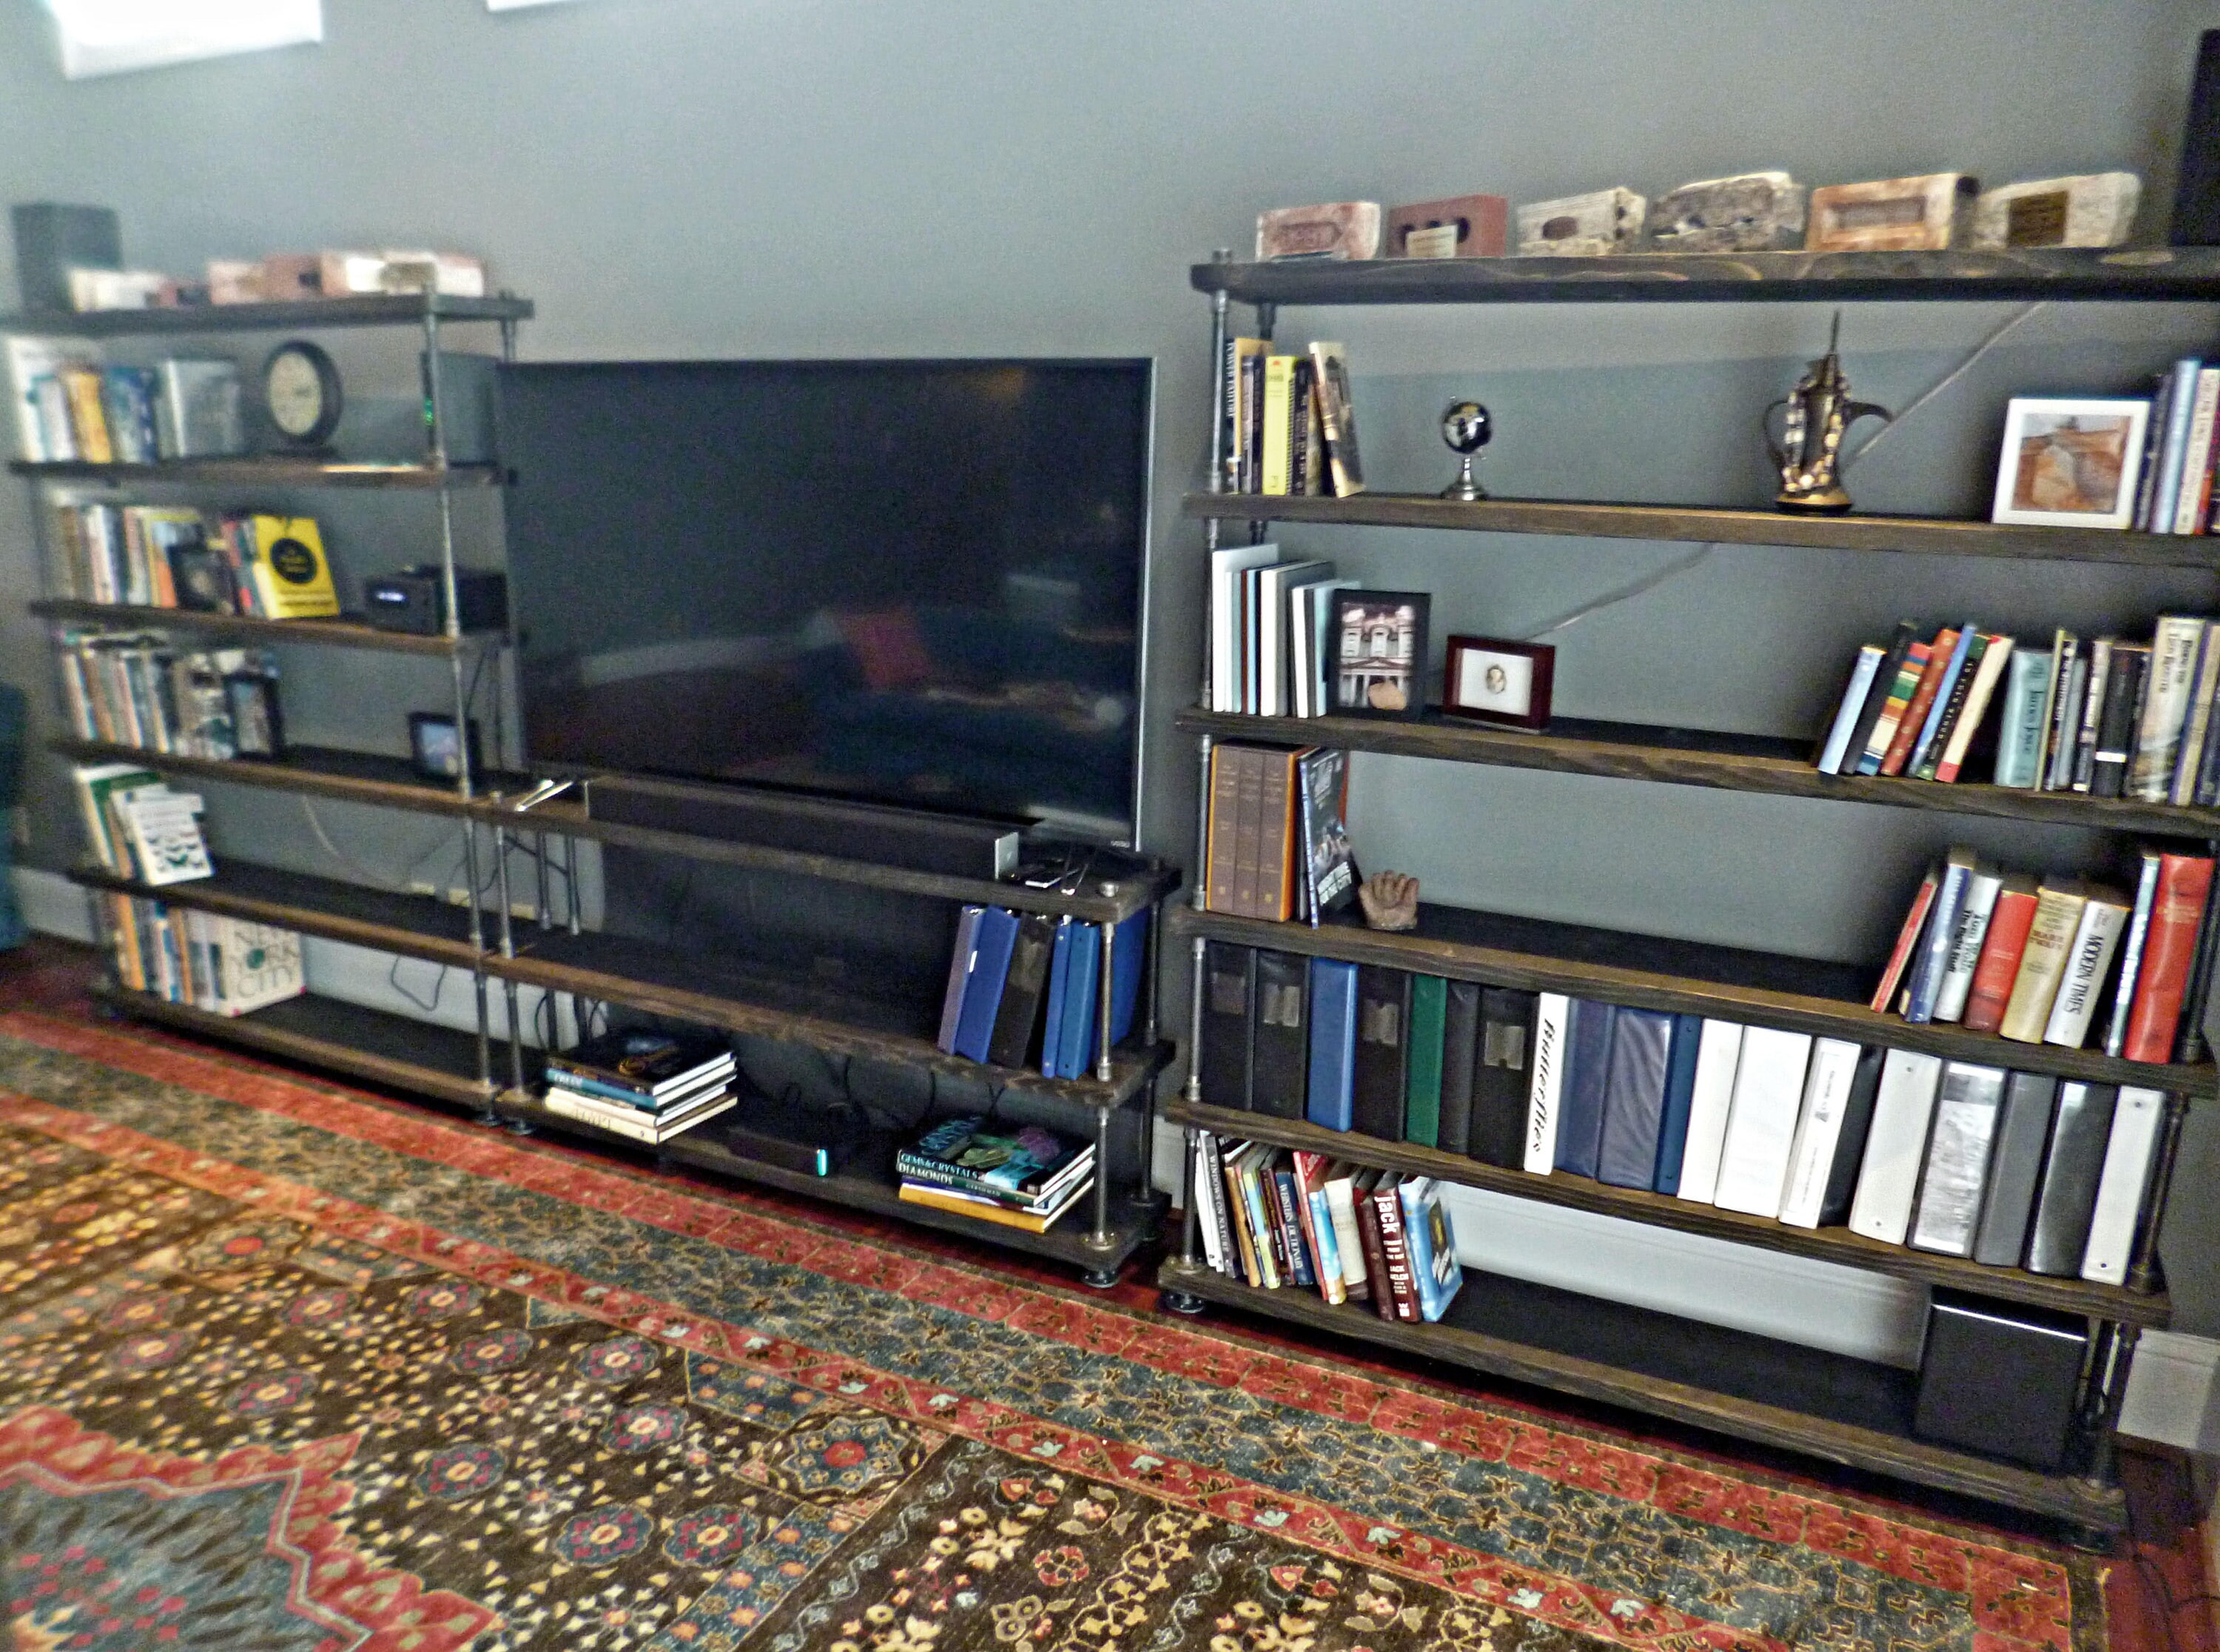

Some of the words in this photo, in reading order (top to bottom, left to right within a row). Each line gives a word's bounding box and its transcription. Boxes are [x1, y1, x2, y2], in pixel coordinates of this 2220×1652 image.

[2077, 934, 2105, 981] MODERN
[2063, 981, 2090, 1016] TIMES
[1533, 1018, 1555, 1152] Butterflies
[898, 1162, 953, 1185] DIAMONDS
[1209, 1155, 1221, 1200] WINDOWS
[1215, 1201, 1223, 1215] ON
[1373, 1196, 1401, 1235] jack
[1218, 1216, 1230, 1253] NATURE
